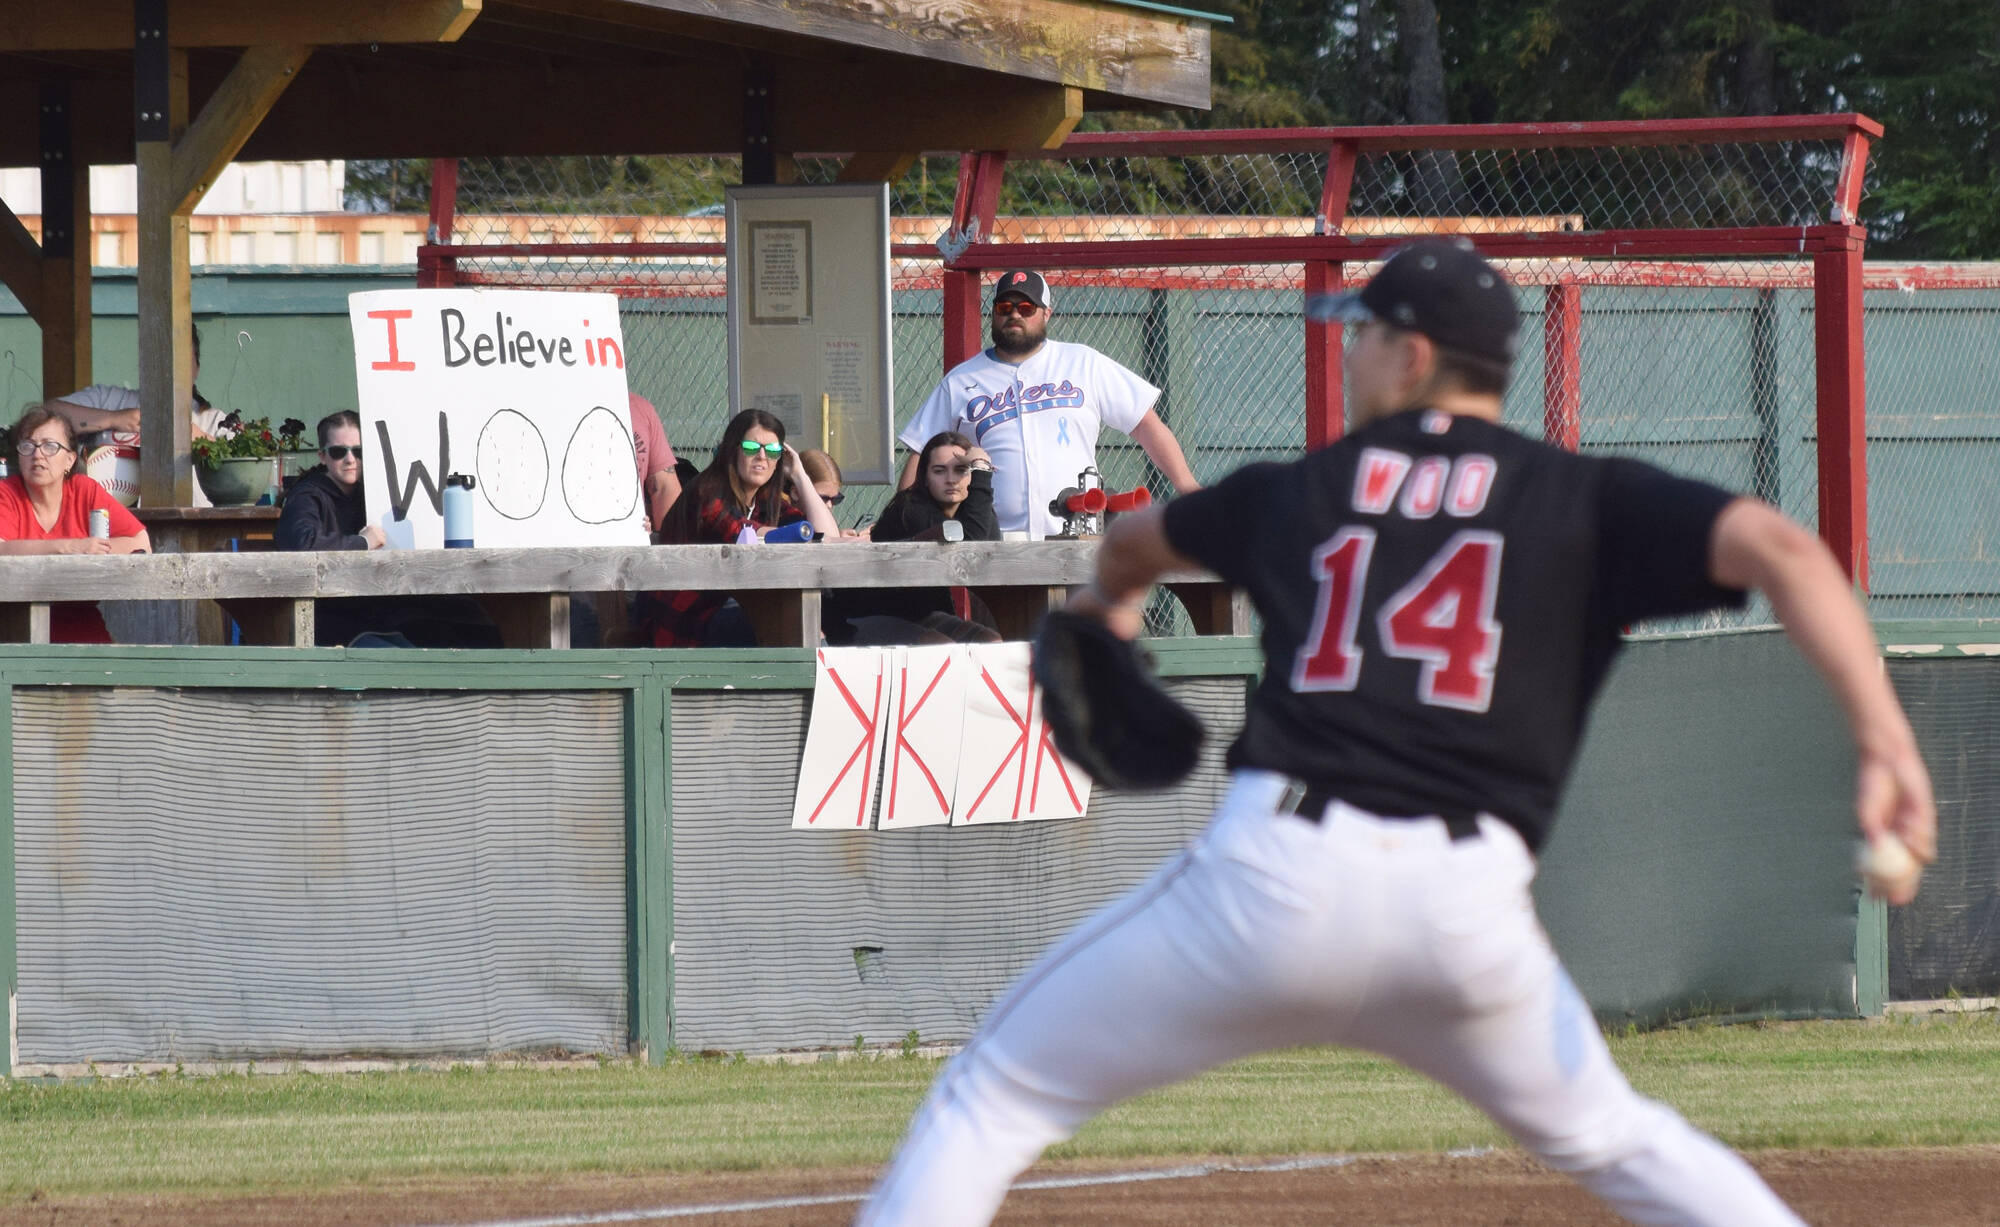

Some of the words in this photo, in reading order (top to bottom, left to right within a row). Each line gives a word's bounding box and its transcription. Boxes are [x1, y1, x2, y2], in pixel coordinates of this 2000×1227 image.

[367, 309, 416, 371] I
[440, 308, 577, 368] Believe
[583, 319, 624, 369] in
[967, 380, 1083, 423] Oilers
[375, 406, 639, 524] WOO
[1351, 446, 1498, 519] WOO
[1290, 524, 1504, 714] 14
[887, 649, 951, 820] K
